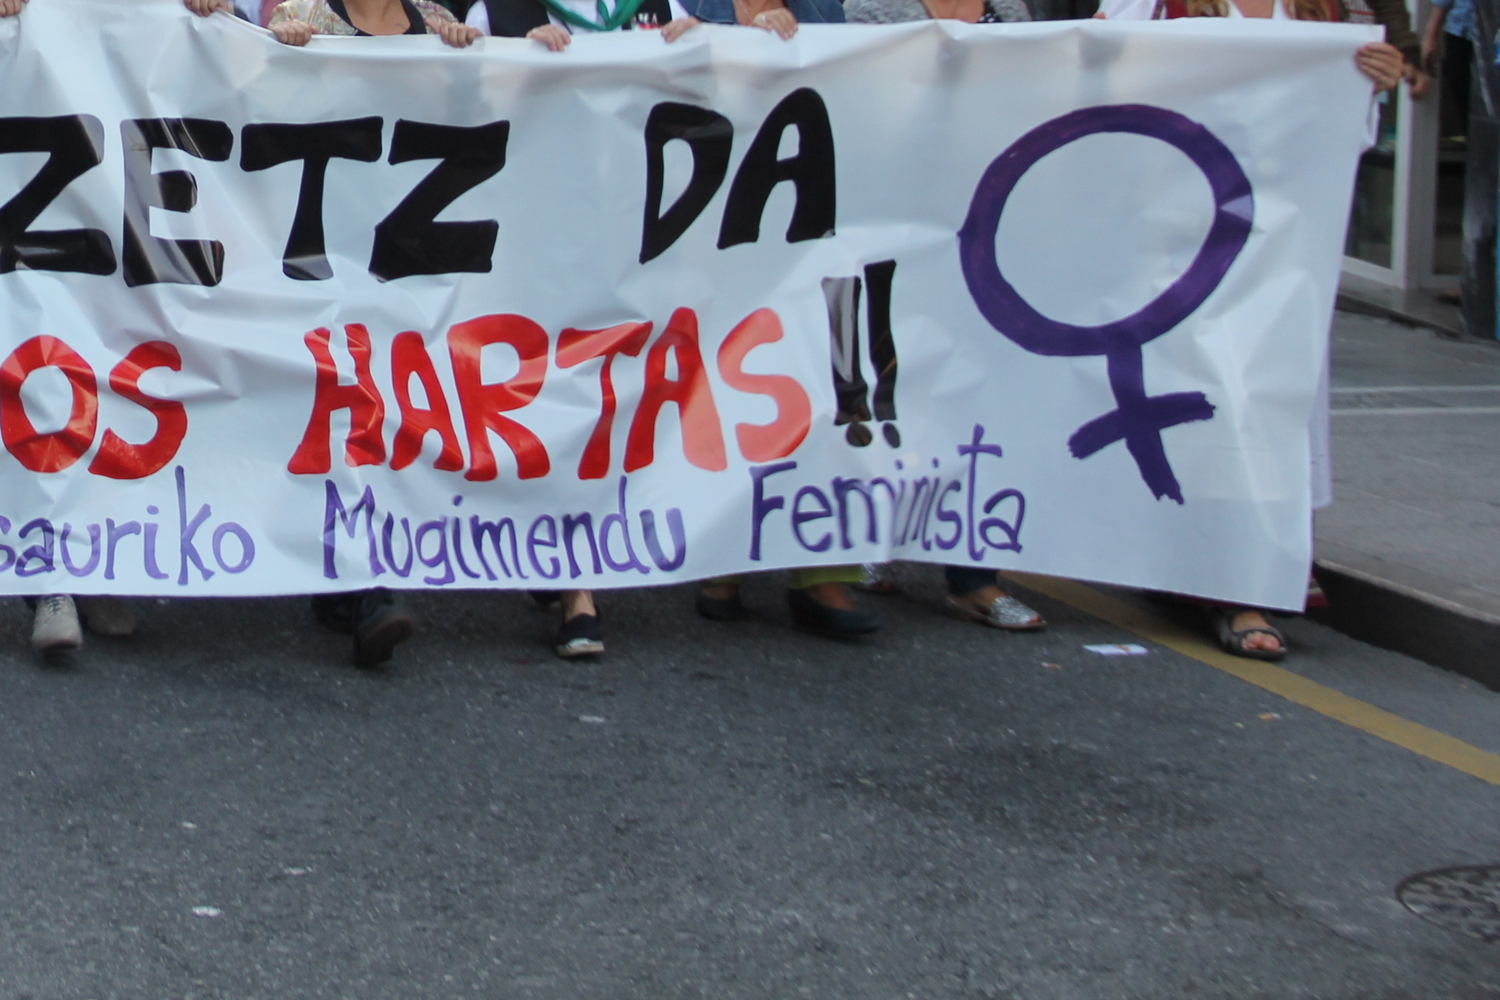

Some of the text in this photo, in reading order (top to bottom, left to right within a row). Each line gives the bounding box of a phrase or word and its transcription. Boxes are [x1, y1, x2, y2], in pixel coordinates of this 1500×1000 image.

[640, 87, 837, 264] DA
[322, 476, 687, 586] Mugimendu
[749, 424, 1026, 562] Feminista
